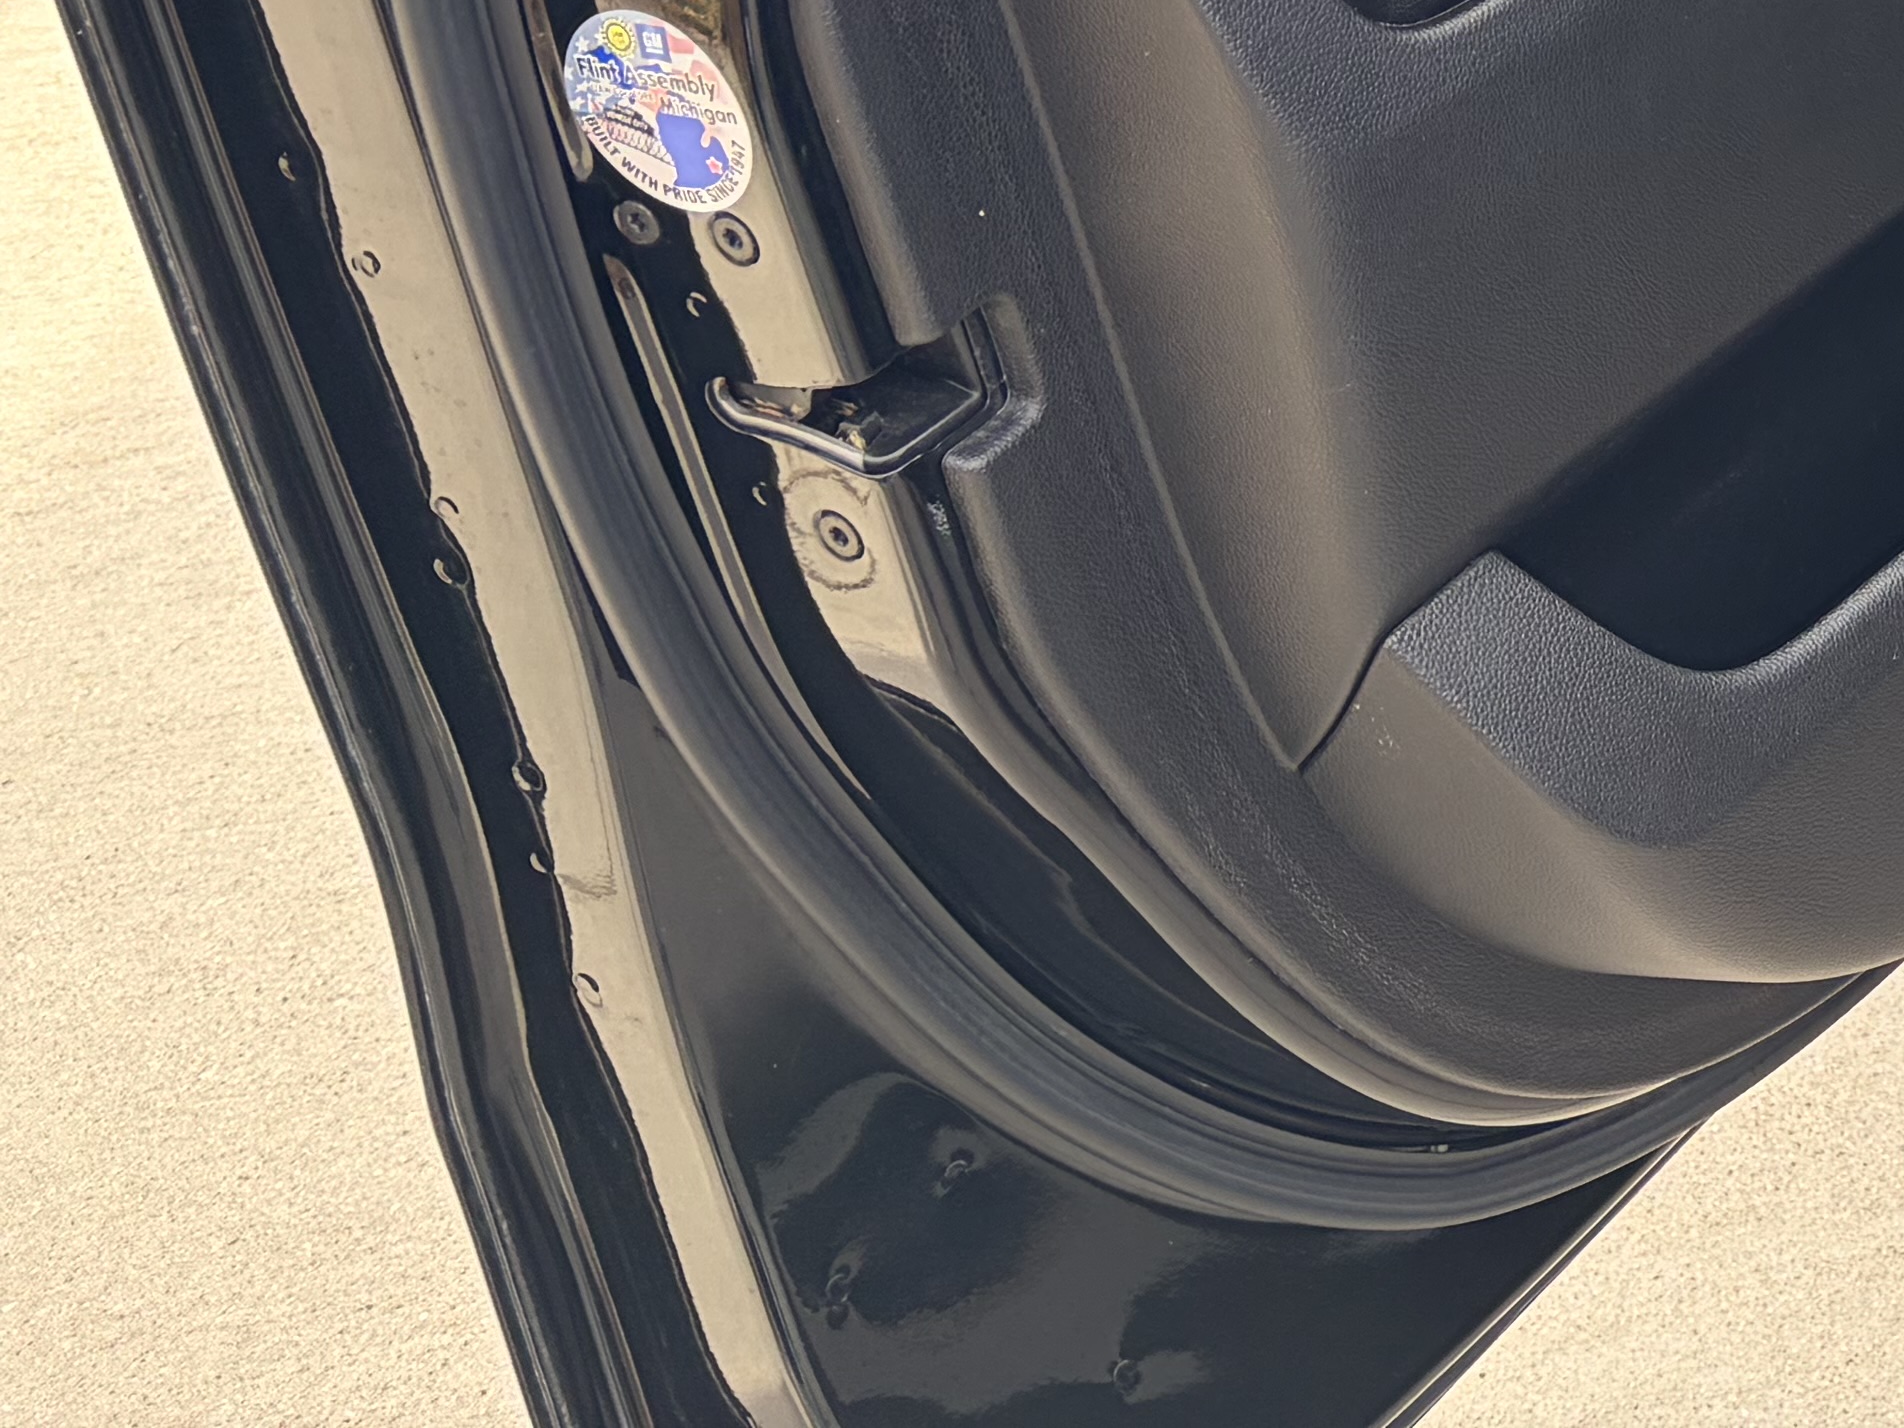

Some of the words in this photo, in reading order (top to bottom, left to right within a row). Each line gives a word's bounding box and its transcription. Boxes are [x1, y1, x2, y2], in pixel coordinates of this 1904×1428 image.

[642, 30, 665, 50] GM
[575, 56, 620, 85] Flint
[627, 62, 717, 103] Assembly
[659, 96, 738, 126] Michigan
[584, 115, 621, 157] BUILT
[621, 156, 659, 192] WITH
[663, 182, 708, 205] PRIDE
[706, 175, 739, 204] SINCE
[728, 139, 747, 176] 1947
